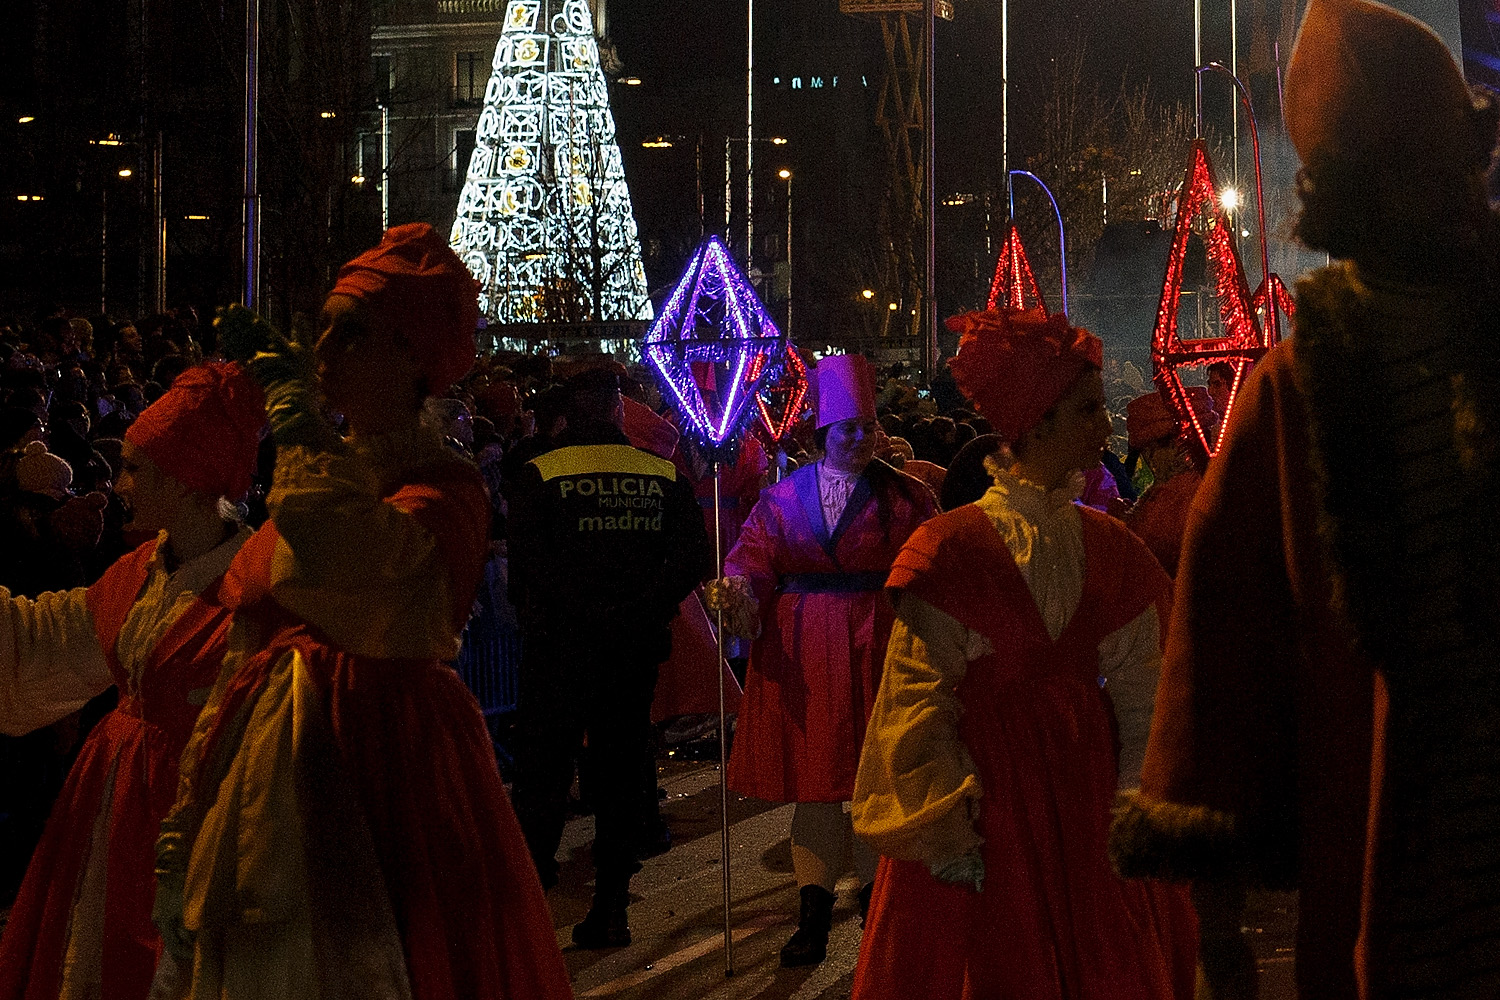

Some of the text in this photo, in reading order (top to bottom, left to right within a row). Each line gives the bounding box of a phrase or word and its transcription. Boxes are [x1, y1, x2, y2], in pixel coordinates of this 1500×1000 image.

[559, 478, 664, 499] POLICIA
[598, 497, 665, 511] MUNICIPAL
[578, 510, 663, 532] madrid
